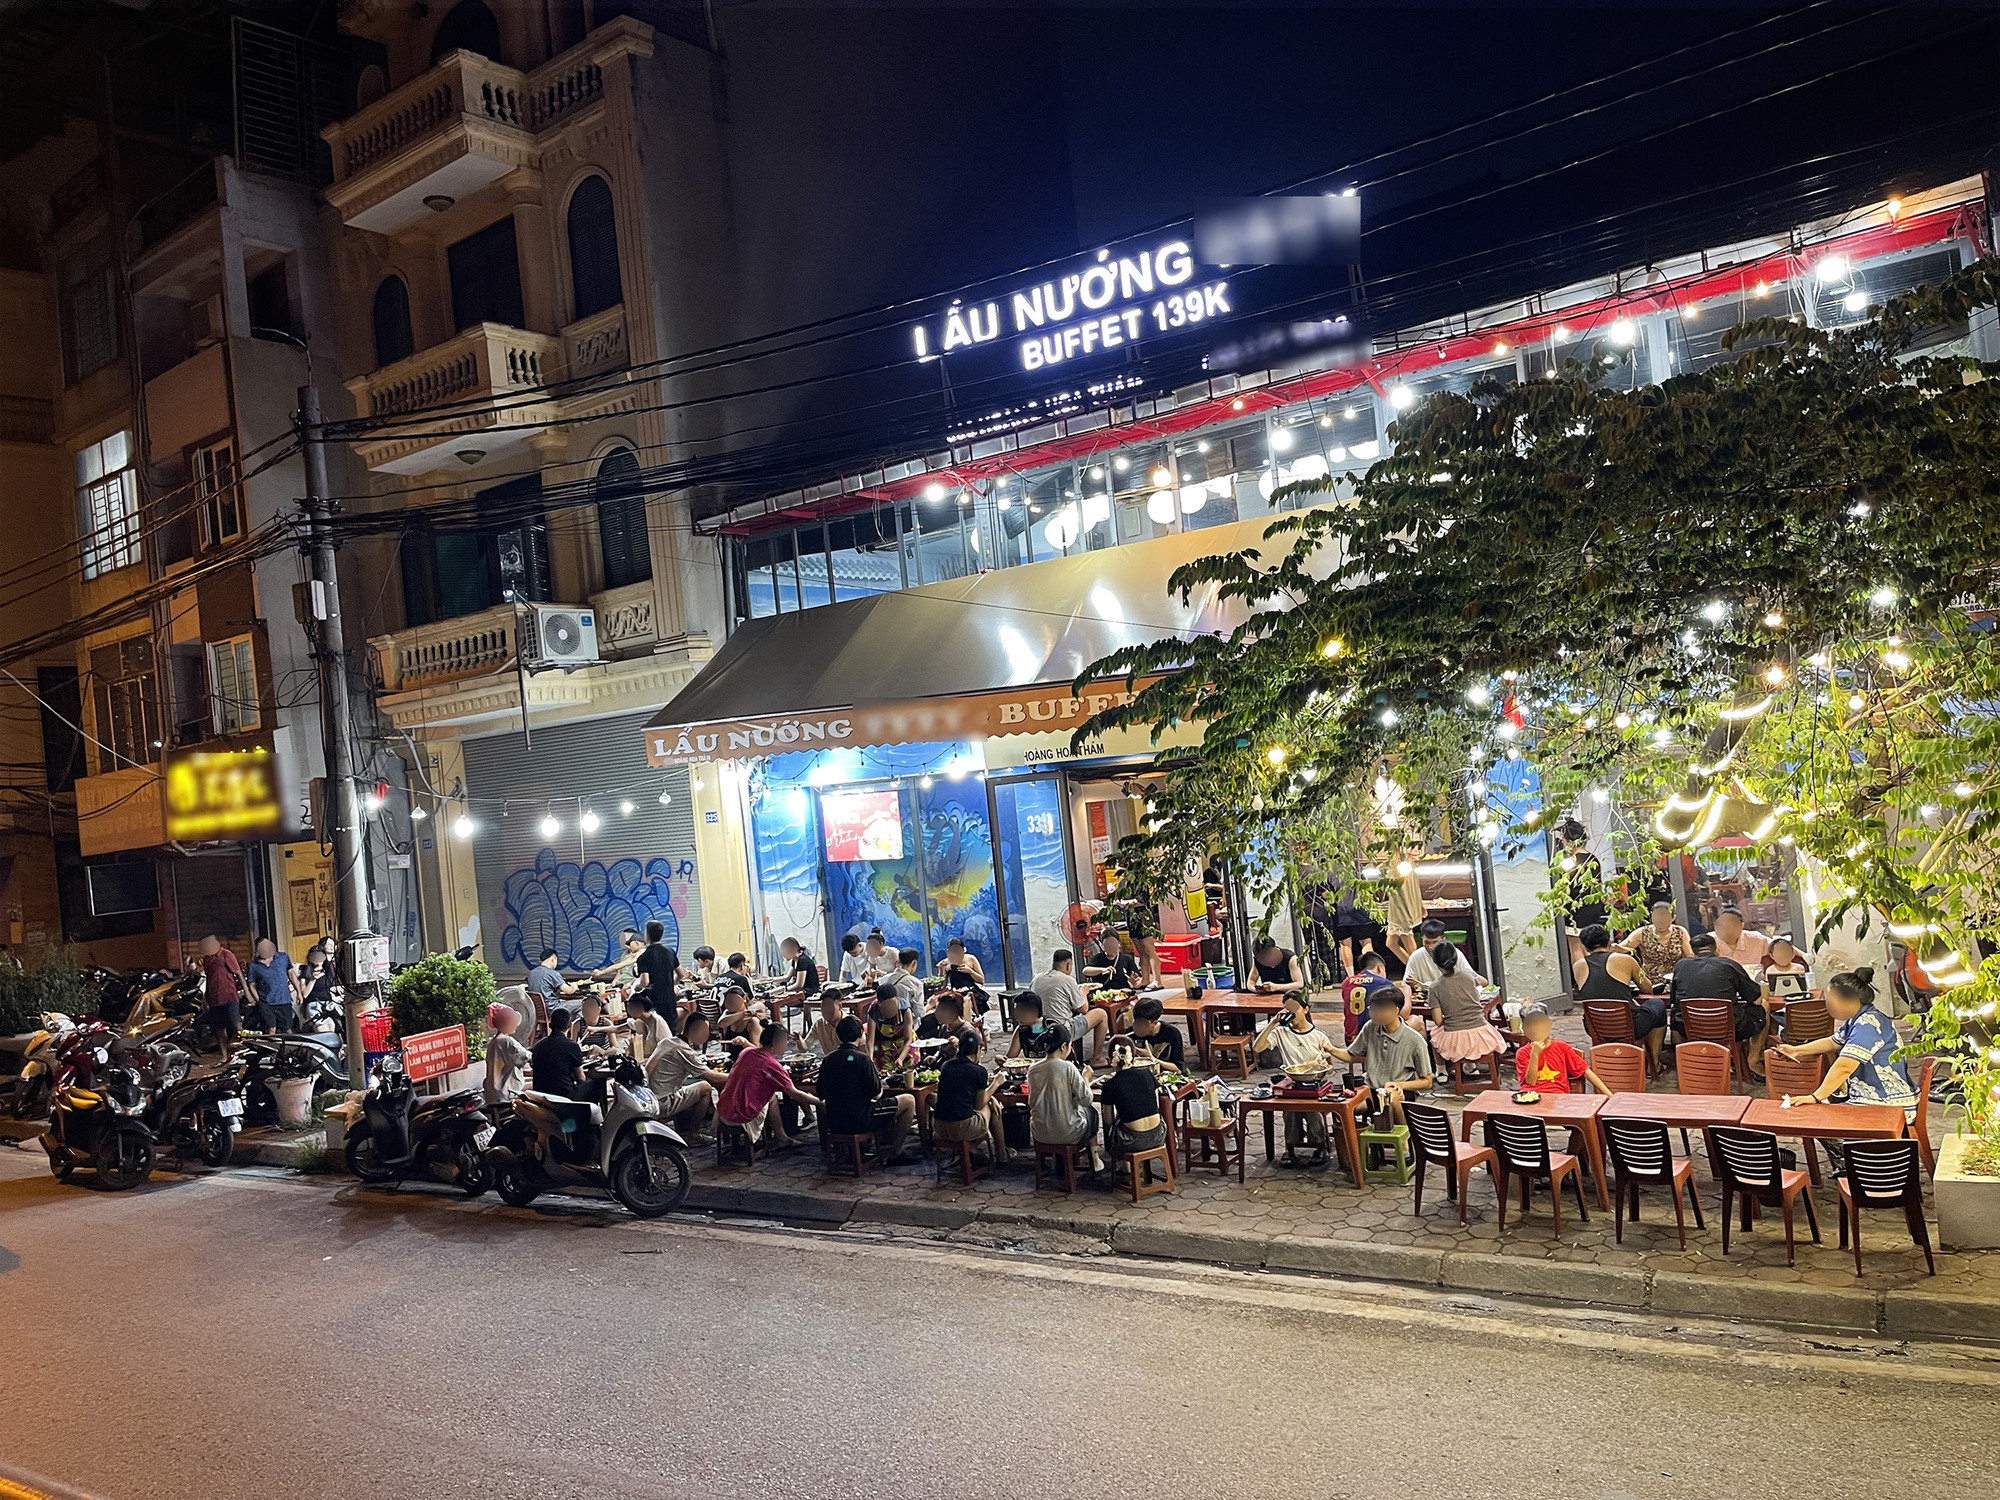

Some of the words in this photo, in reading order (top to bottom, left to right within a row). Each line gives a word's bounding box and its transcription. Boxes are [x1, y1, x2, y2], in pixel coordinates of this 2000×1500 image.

[1013, 242, 1193, 332] NƯỚNG
[1022, 308, 1142, 371] BUFFET
[1152, 282, 1231, 332] 139K
[653, 726, 719, 757] LẨU
[727, 719, 853, 751] NƯỚNG
[1056, 747, 1073, 759] HO
[1350, 986, 1367, 1016] 8
